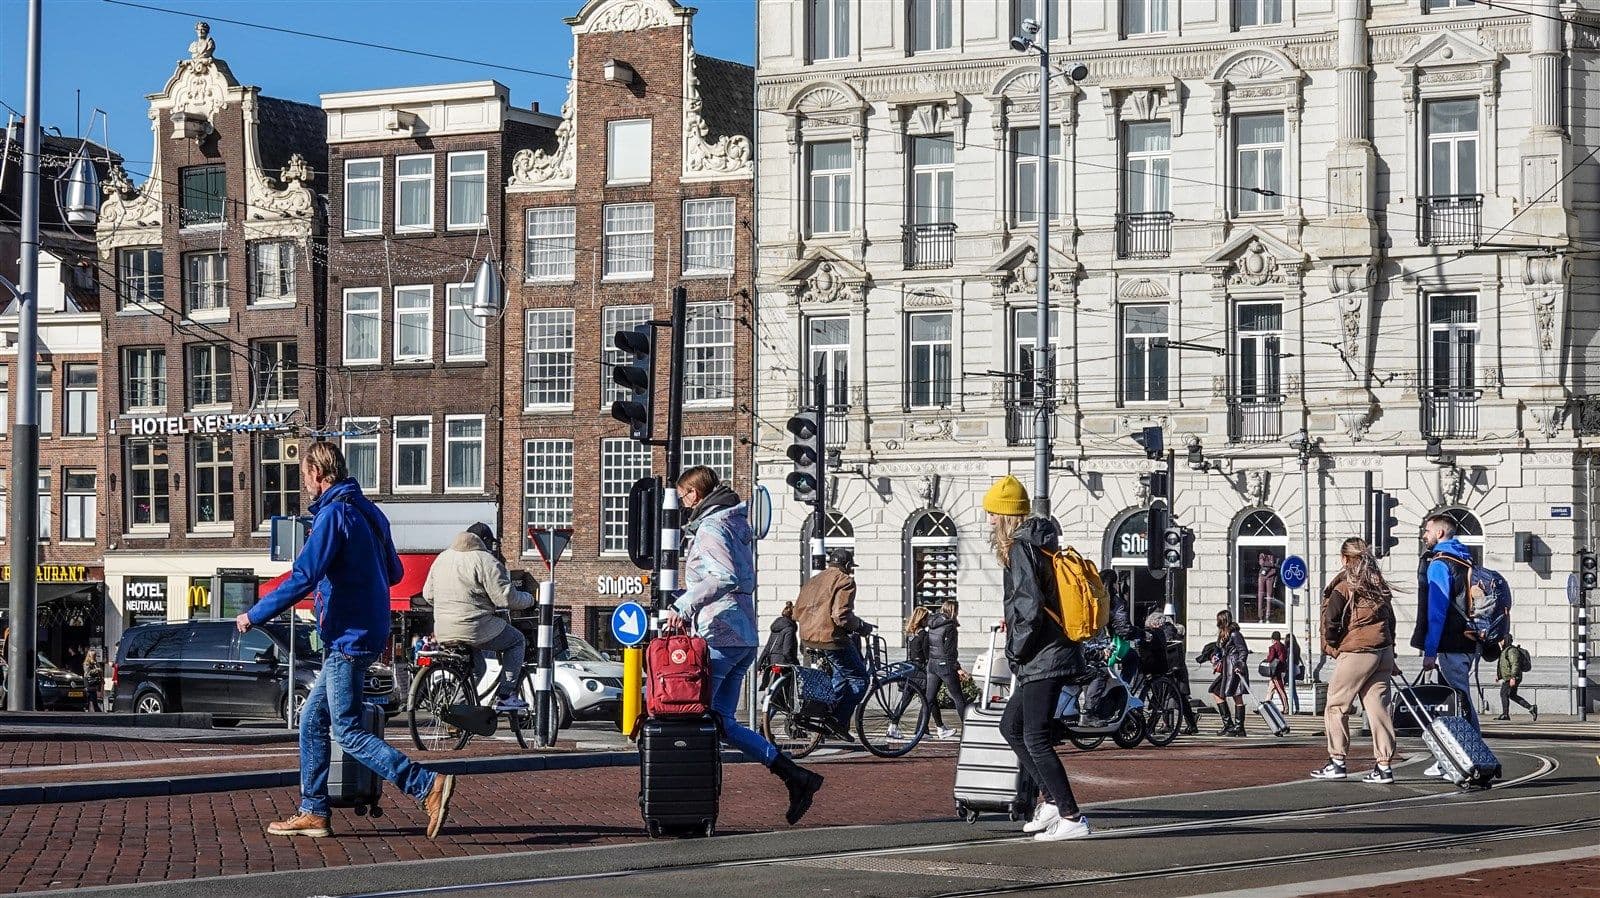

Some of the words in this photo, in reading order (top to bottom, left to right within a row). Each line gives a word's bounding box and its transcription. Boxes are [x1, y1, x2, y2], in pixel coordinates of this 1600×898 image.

[131, 416, 189, 435] HOTEL
[1121, 532, 1148, 553] sni
[4, 566, 85, 582] RAURANT
[126, 583, 164, 597] HOTEL
[597, 575, 643, 598] snipes
[126, 600, 165, 611] NEUTRAAL
